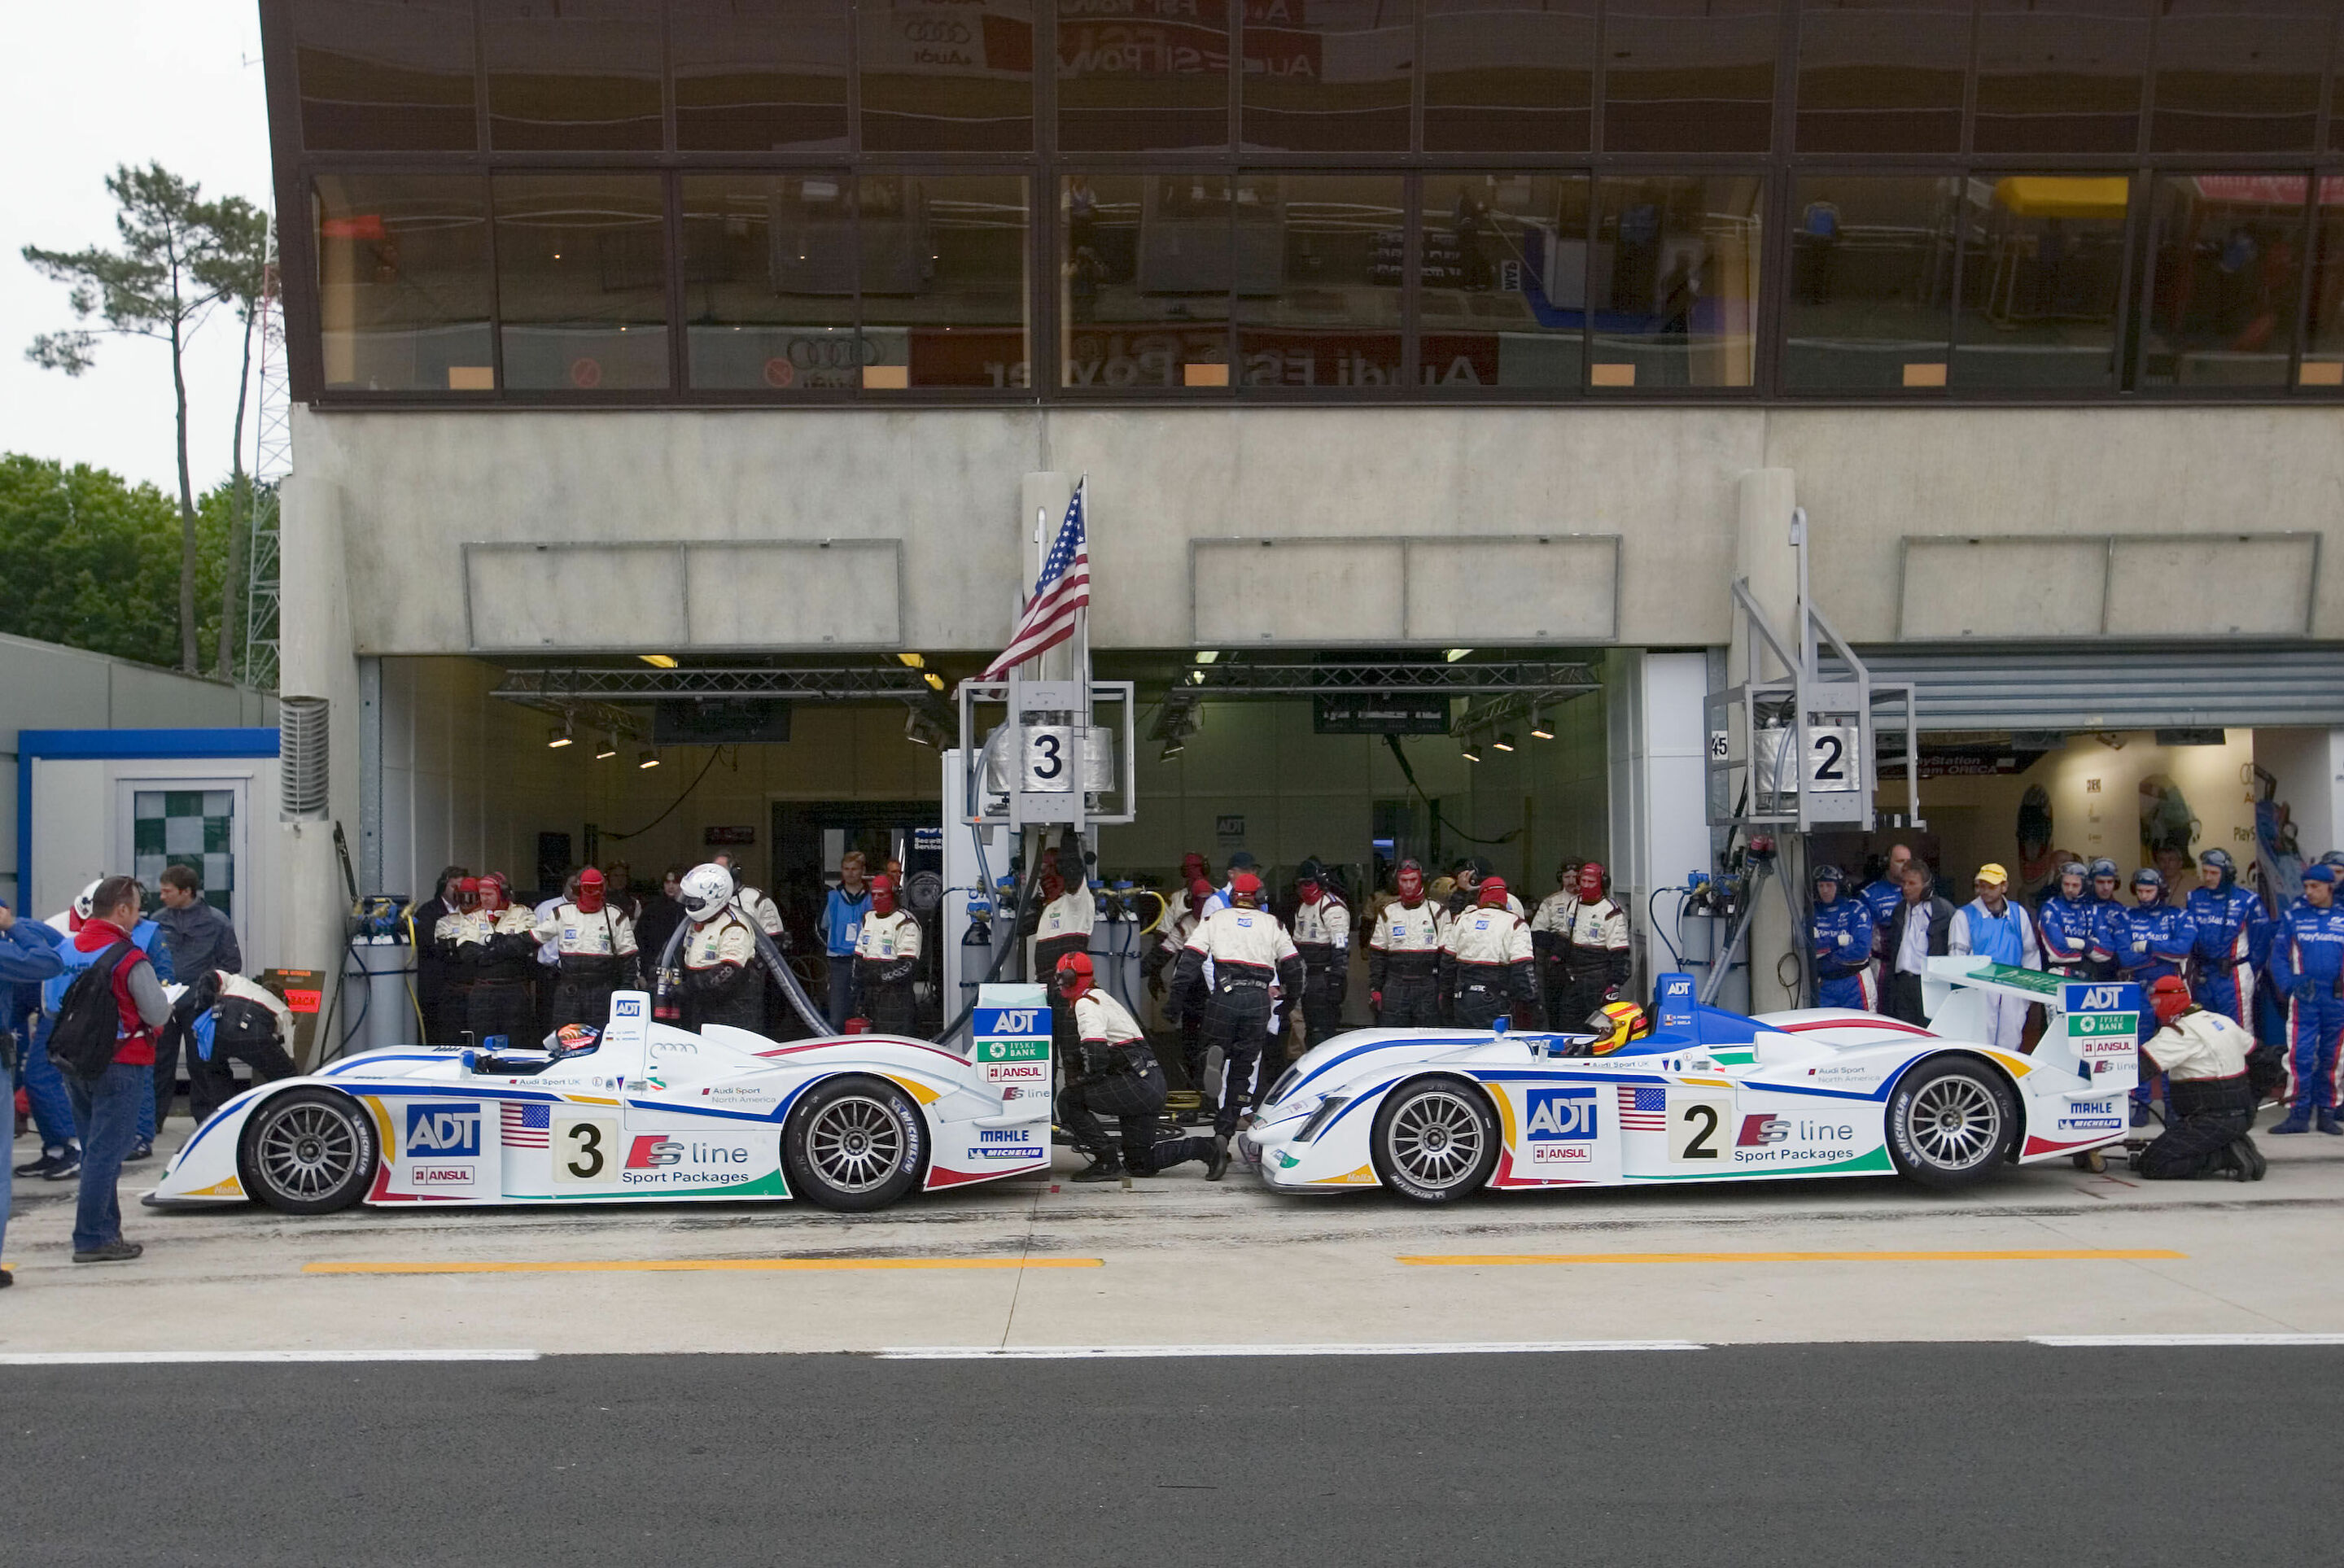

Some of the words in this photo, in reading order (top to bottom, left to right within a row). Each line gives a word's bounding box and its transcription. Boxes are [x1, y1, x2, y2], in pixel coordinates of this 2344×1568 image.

[1034, 735, 1061, 779] 3
[1814, 736, 1843, 780] 2
[1667, 982, 1690, 995] ADT
[2080, 987, 2123, 1009] ADT
[616, 1002, 640, 1015] ADT
[992, 1010, 1039, 1033] ADT
[2099, 1023, 2124, 1031] BANK
[1010, 1049, 1036, 1057] BANK
[2097, 1042, 2132, 1052] ANSUL
[1003, 1067, 1042, 1077] ANSUL
[2117, 1062, 2137, 1072] line
[542, 1078, 566, 1086] Sport
[735, 1087, 761, 1095] Sport
[1028, 1087, 1050, 1098] line
[2071, 1102, 2113, 1114] MAHLE
[1527, 1098, 1598, 1134] ADT
[1893, 1091, 1912, 1155] MICHELIN
[2074, 1119, 2120, 1128] MICHELIN
[407, 1112, 481, 1150] ADT
[980, 1129, 1030, 1142] MAHLE
[1682, 1105, 1718, 1158] 2
[1800, 1120, 1853, 1141] line
[901, 1111, 920, 1175] MICHELIN
[567, 1123, 604, 1178] 3
[693, 1142, 748, 1164] line
[986, 1148, 1041, 1157] MICHELIN
[1548, 1148, 1587, 1159] ANSUL
[1734, 1151, 1777, 1164] Sport
[1781, 1148, 1855, 1162] Packages
[428, 1170, 470, 1181] ANSUL
[622, 1171, 667, 1185] Sport
[672, 1171, 750, 1185] Packages
